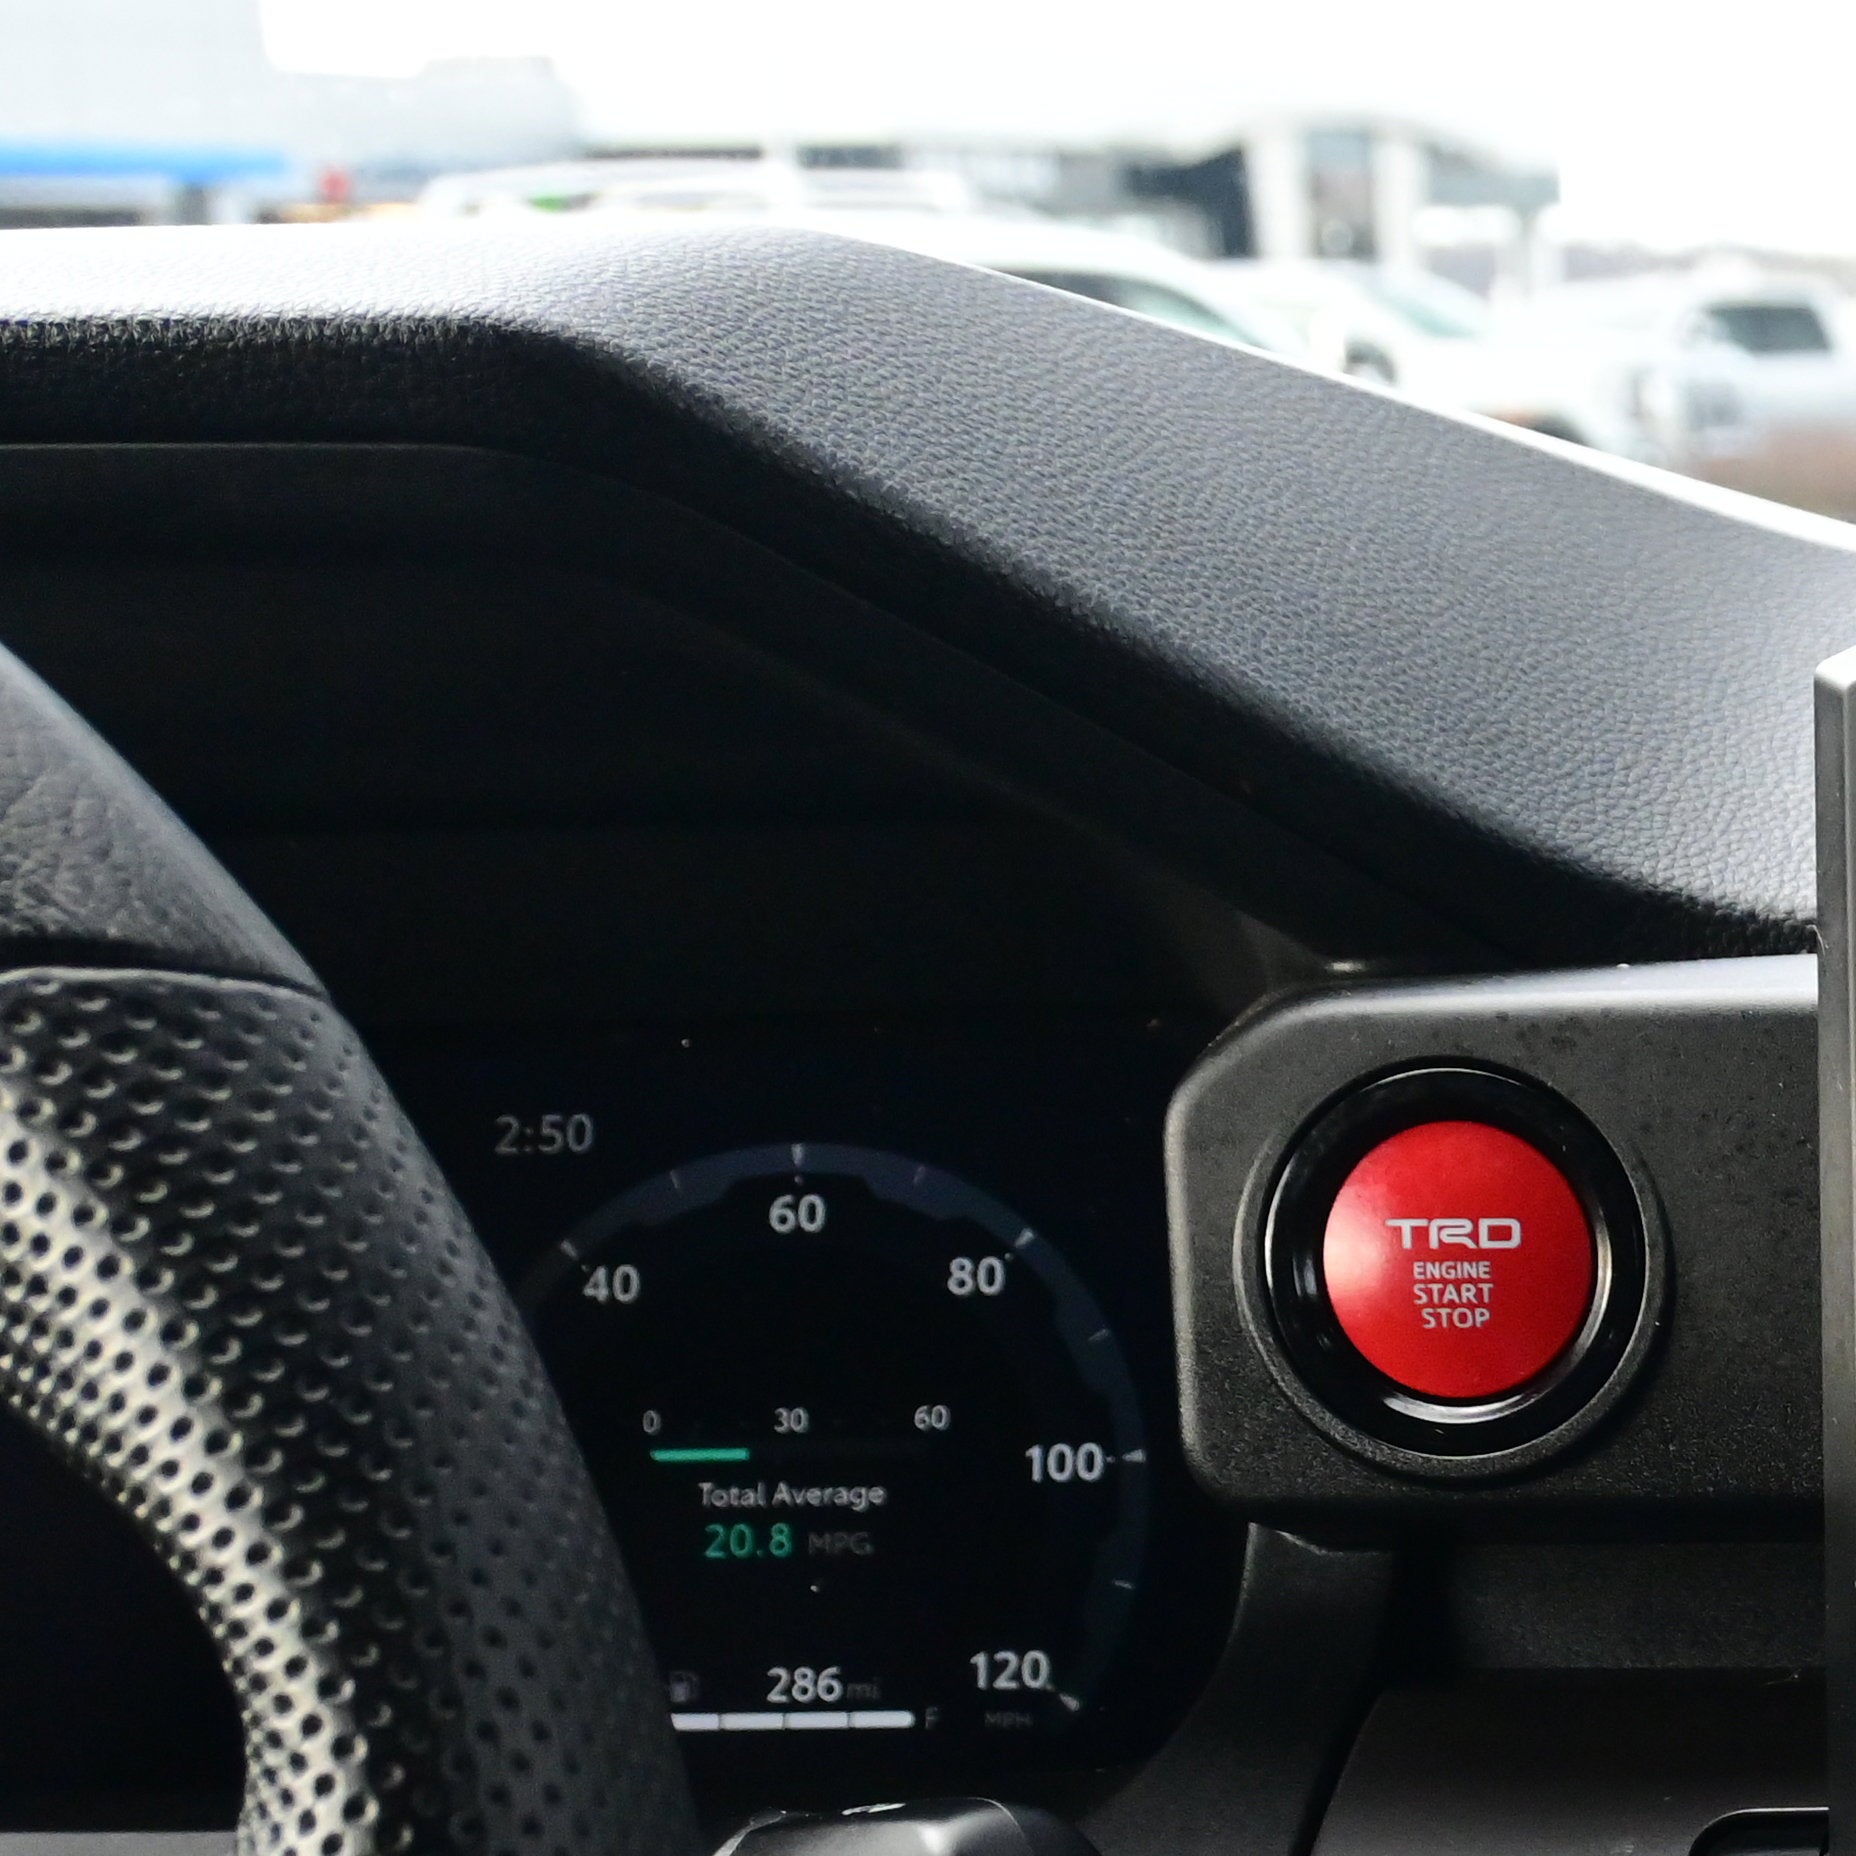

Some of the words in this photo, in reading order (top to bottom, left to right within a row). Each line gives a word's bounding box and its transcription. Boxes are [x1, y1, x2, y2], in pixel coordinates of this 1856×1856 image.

[496, 1114, 593, 1153] 2:50
[768, 1195, 826, 1233] 60
[1385, 1218, 1521, 1249] TRD
[584, 1264, 640, 1302] 40
[948, 1257, 1004, 1296] 80
[1413, 1261, 1491, 1280] ENGINE
[1413, 1283, 1493, 1304] START
[1423, 1308, 1490, 1328] STOP
[643, 1410, 660, 1433] 0
[775, 1408, 807, 1432] 30
[915, 1405, 947, 1429] 60
[1026, 1443, 1102, 1483] 100
[699, 1483, 765, 1506] Total
[773, 1482, 885, 1511] Average
[705, 1523, 791, 1558] 20.8
[809, 1532, 873, 1554] MPG
[766, 1666, 842, 1703] 286
[970, 1650, 1050, 1691] 120
